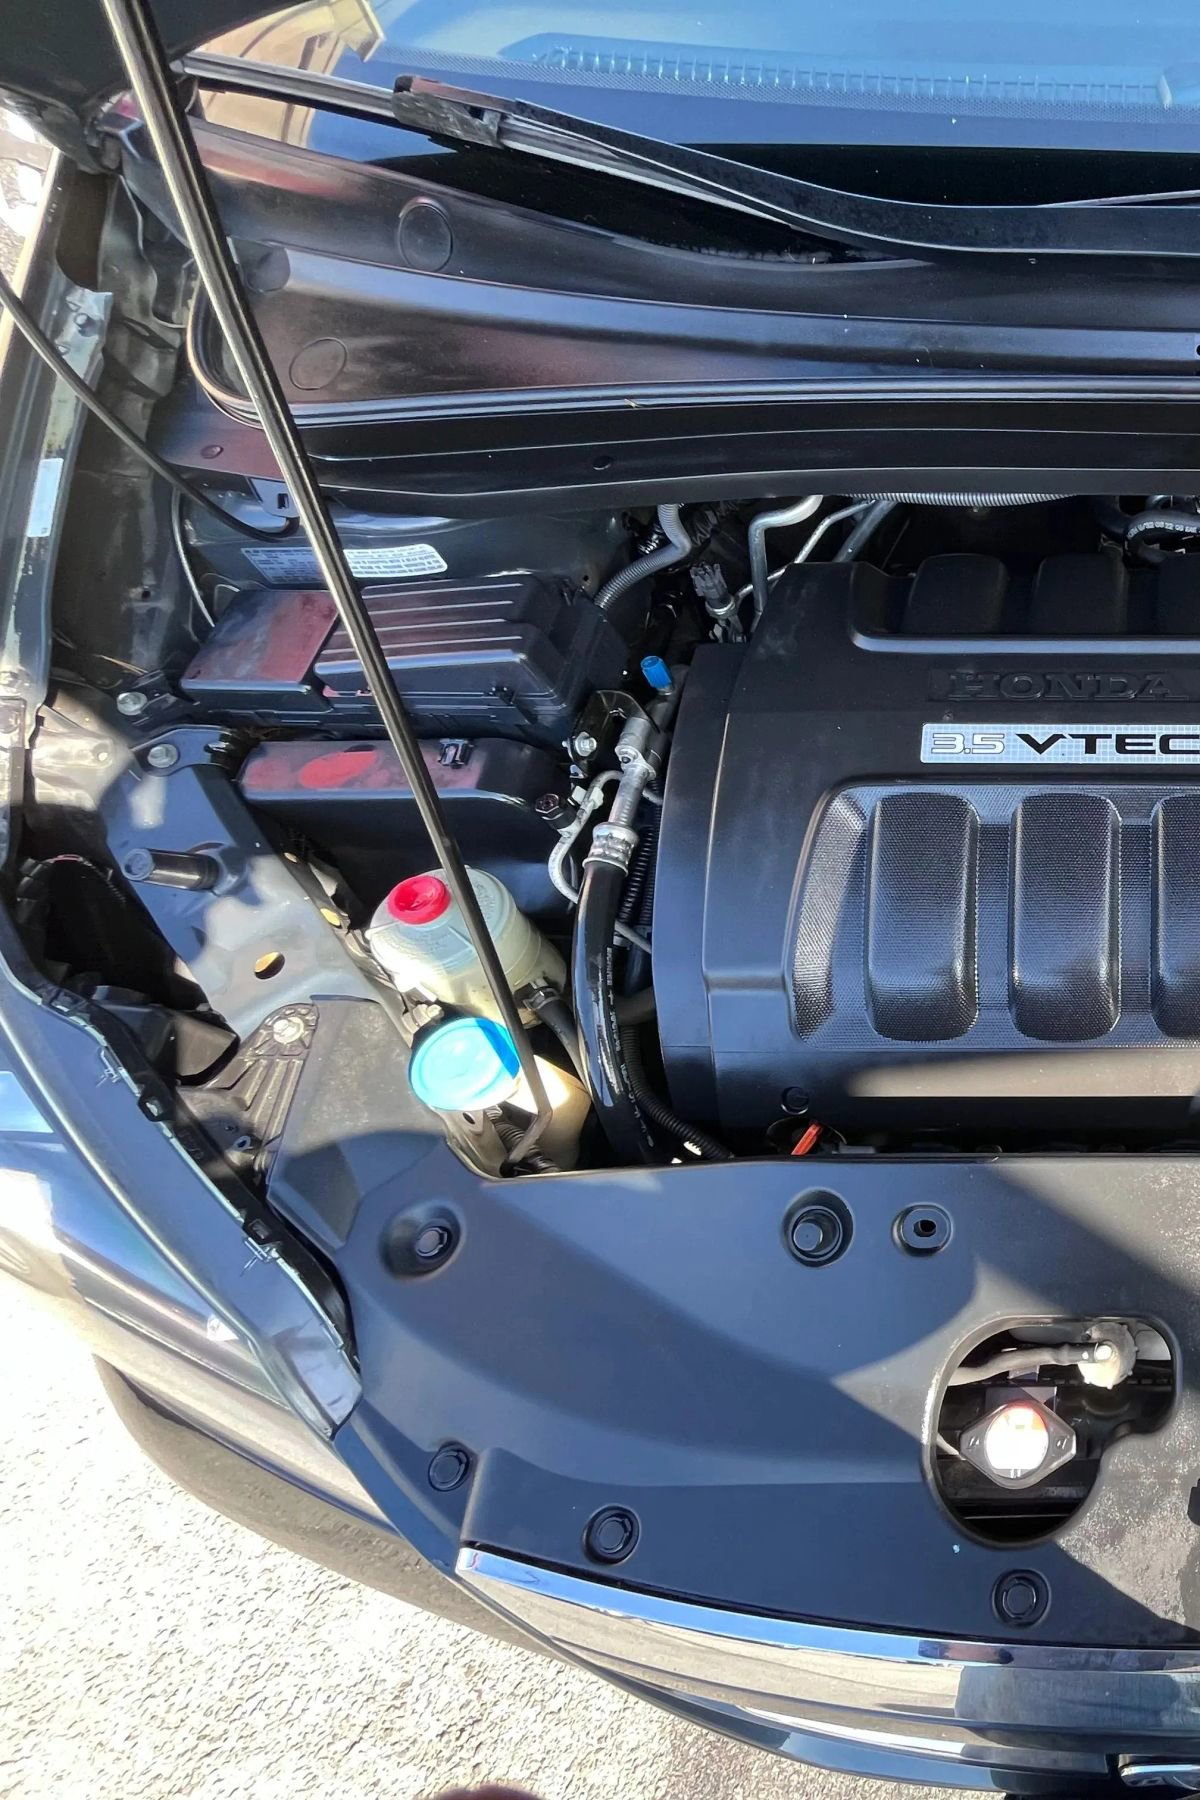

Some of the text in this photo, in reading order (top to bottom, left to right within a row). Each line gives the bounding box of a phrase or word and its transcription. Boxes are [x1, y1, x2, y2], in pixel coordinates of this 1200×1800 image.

[949, 671, 1188, 700] HONDA
[931, 733, 1200, 755] 3.5 VTEC
